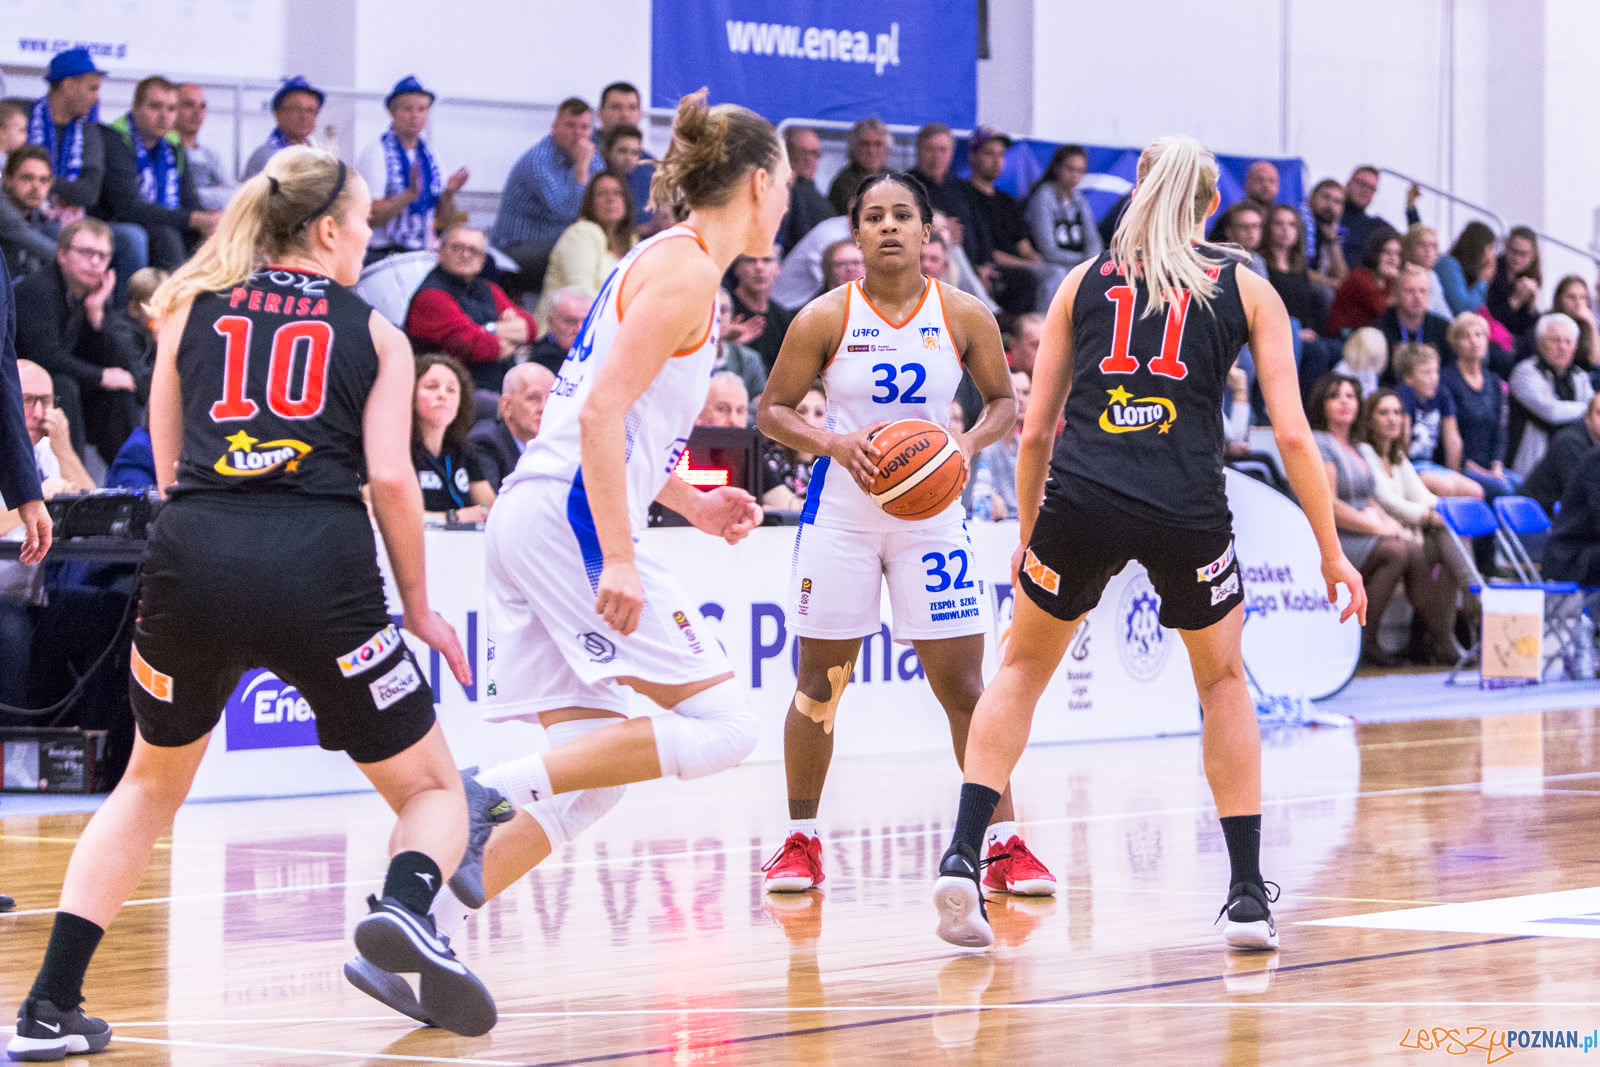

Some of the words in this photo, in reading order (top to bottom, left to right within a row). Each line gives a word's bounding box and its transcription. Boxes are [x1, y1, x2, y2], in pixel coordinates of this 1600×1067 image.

[725, 19, 900, 76] www.enea.pl
[229, 287, 329, 316] PERISA
[1098, 285, 1193, 381] 11
[209, 315, 335, 423] 10
[871, 362, 927, 404] 32
[1112, 404, 1163, 426] LOTTO
[233, 446, 295, 470] LOTTO
[879, 437, 931, 480] molten
[921, 548, 975, 593] 32
[253, 689, 316, 725] Ene
